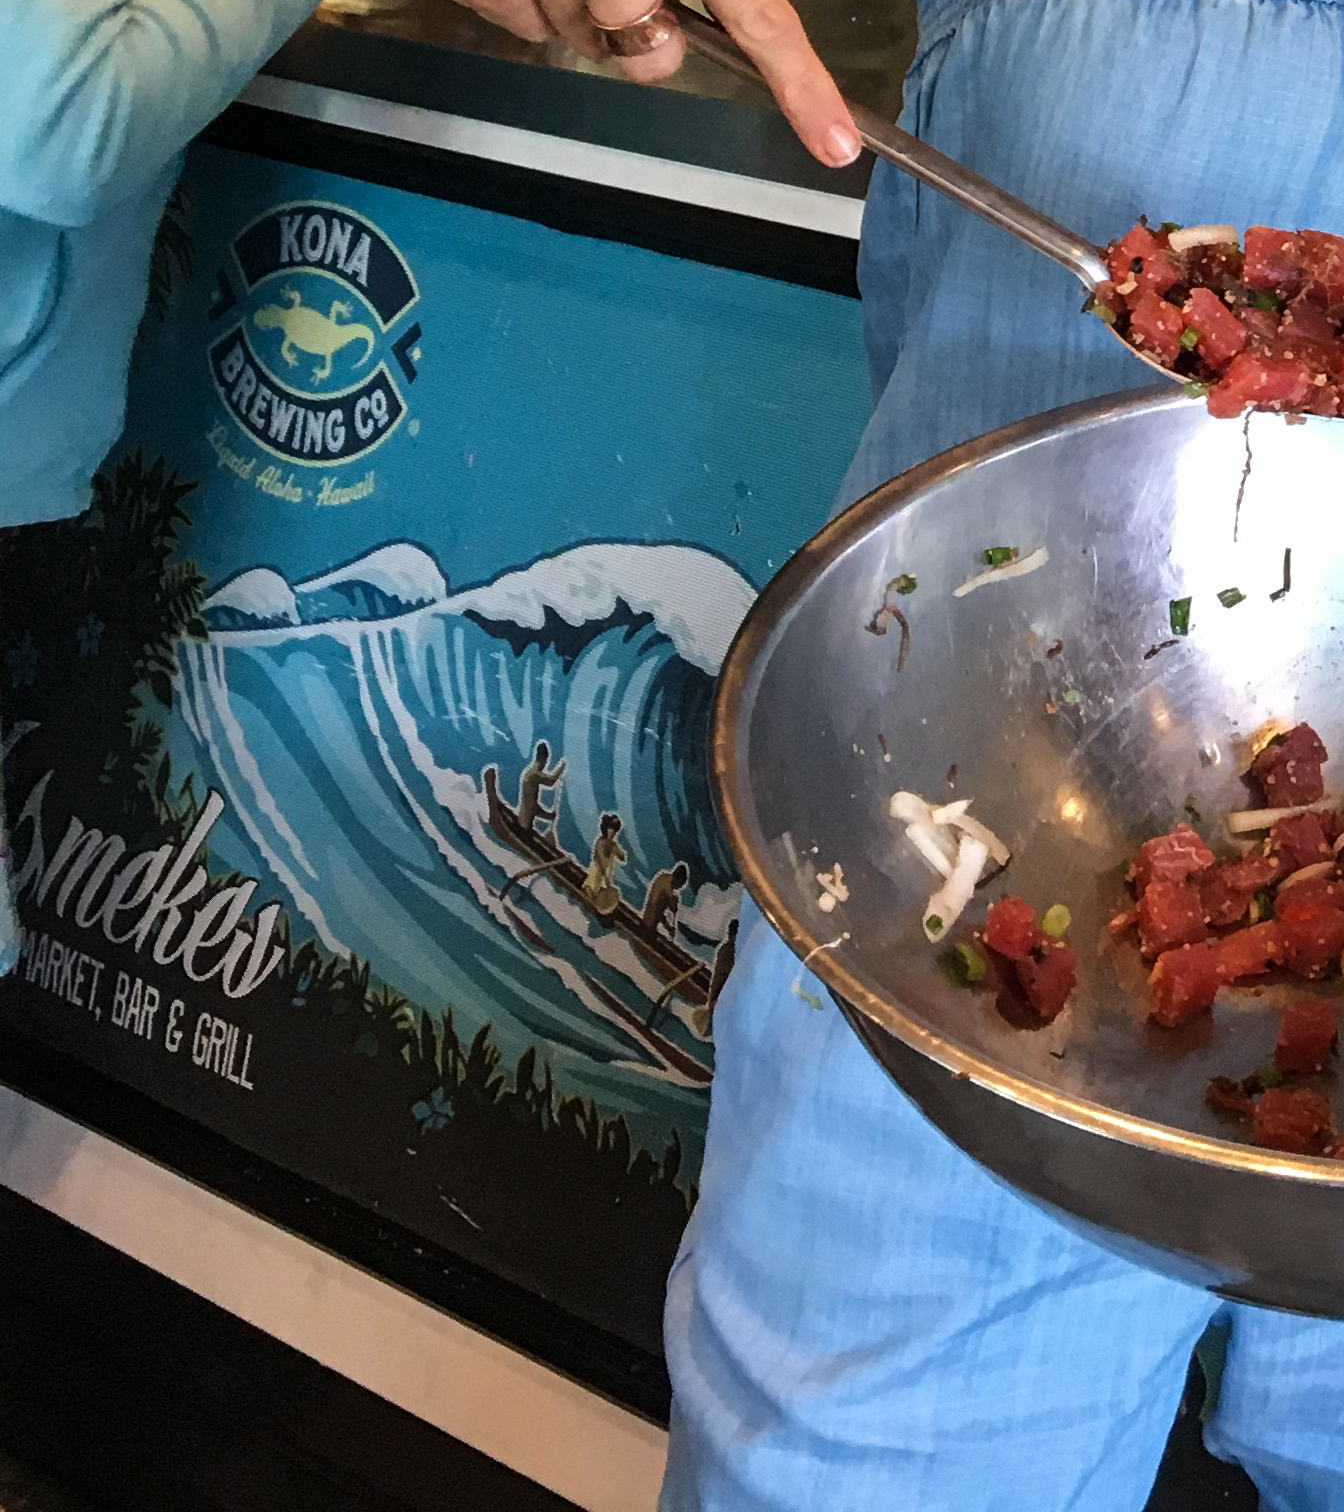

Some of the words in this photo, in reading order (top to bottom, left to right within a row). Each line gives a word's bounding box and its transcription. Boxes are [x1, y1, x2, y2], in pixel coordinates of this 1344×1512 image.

[277, 214, 372, 288] KONA
[218, 340, 347, 455] BREWING
[256, 465, 303, 504] Aloha
[111, 970, 161, 1040] BAR
[165, 999, 186, 1053] &
[192, 1012, 254, 1091] GRILL
